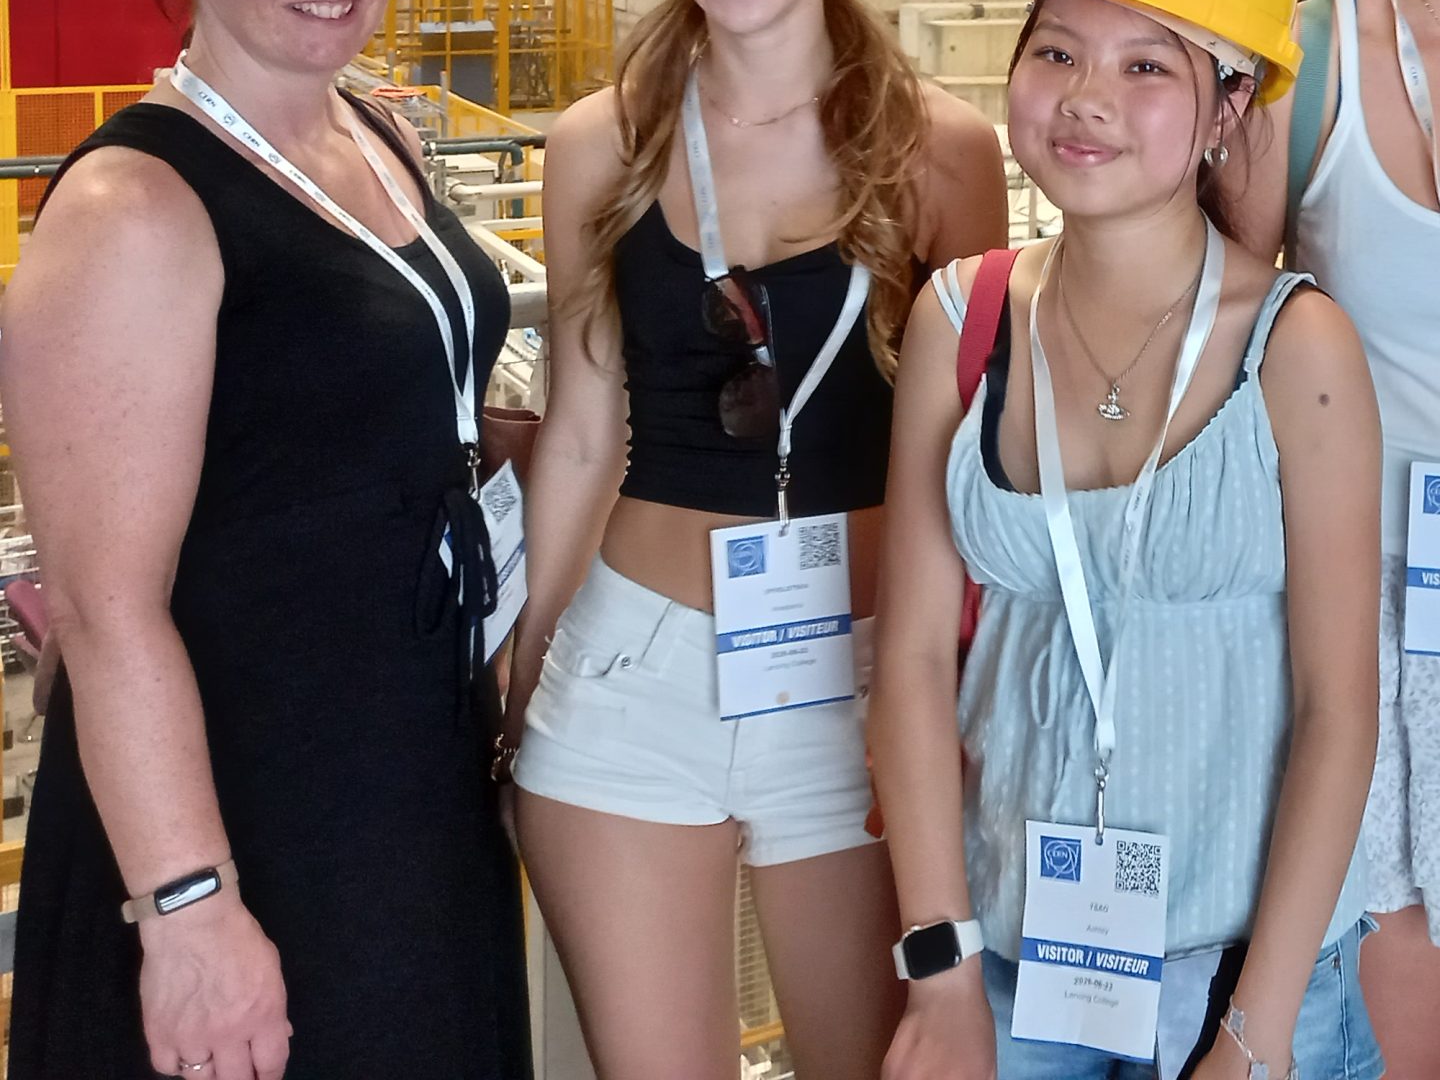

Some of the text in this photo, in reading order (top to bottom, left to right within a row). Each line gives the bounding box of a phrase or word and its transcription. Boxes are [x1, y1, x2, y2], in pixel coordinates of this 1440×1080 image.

[1036, 943, 1150, 976] VISITOR / VISITEUR
